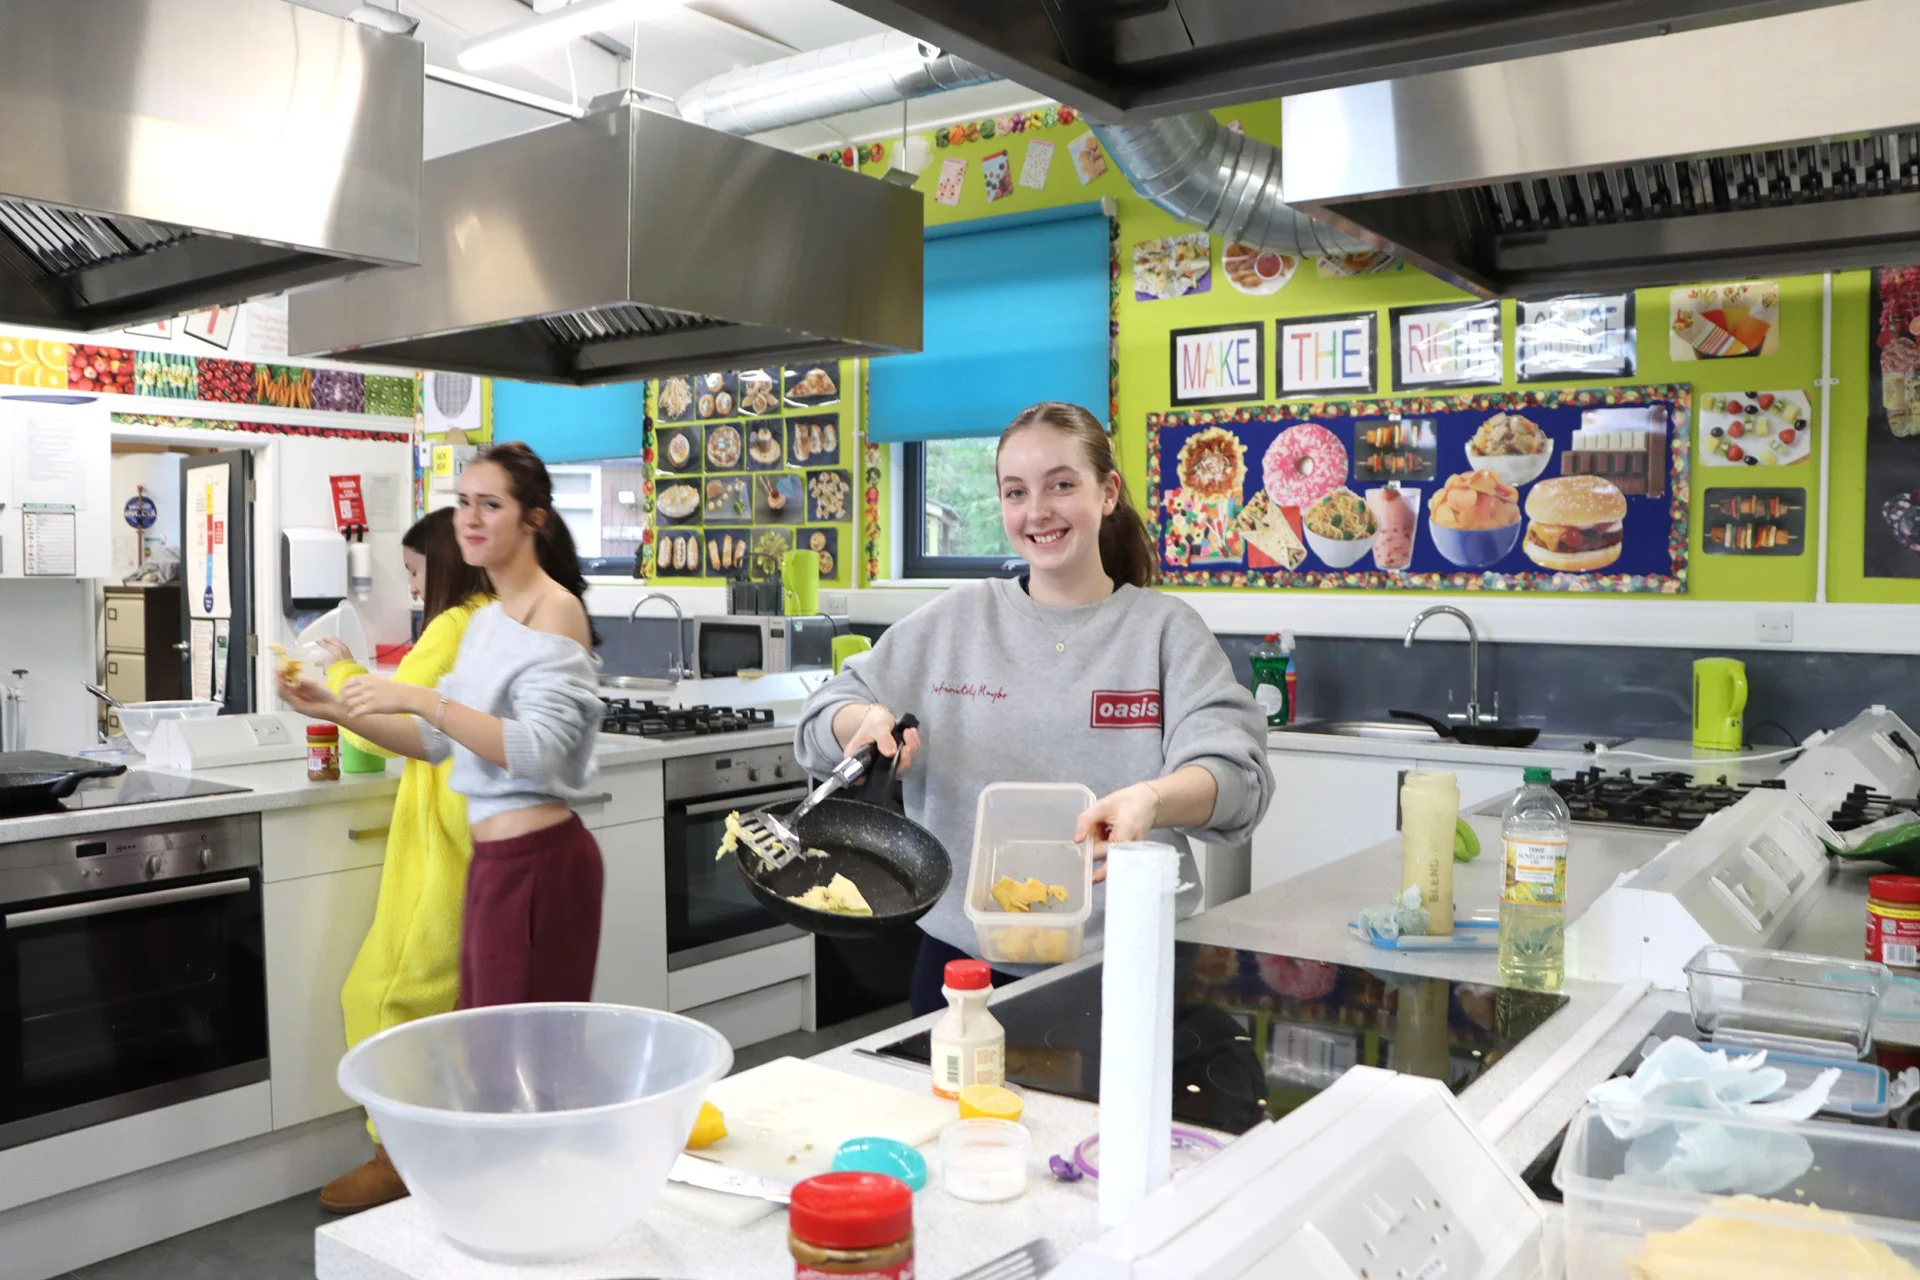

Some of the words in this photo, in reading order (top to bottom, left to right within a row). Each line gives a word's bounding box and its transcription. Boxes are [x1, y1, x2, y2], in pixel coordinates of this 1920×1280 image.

[1184, 338, 1251, 390] MAKE
[1291, 328, 1362, 381] THE
[1408, 319, 1487, 373] RIGHT
[1534, 306, 1618, 362] CCE
[1099, 697, 1160, 718] oasis
[1428, 859, 1440, 903] BLEND
